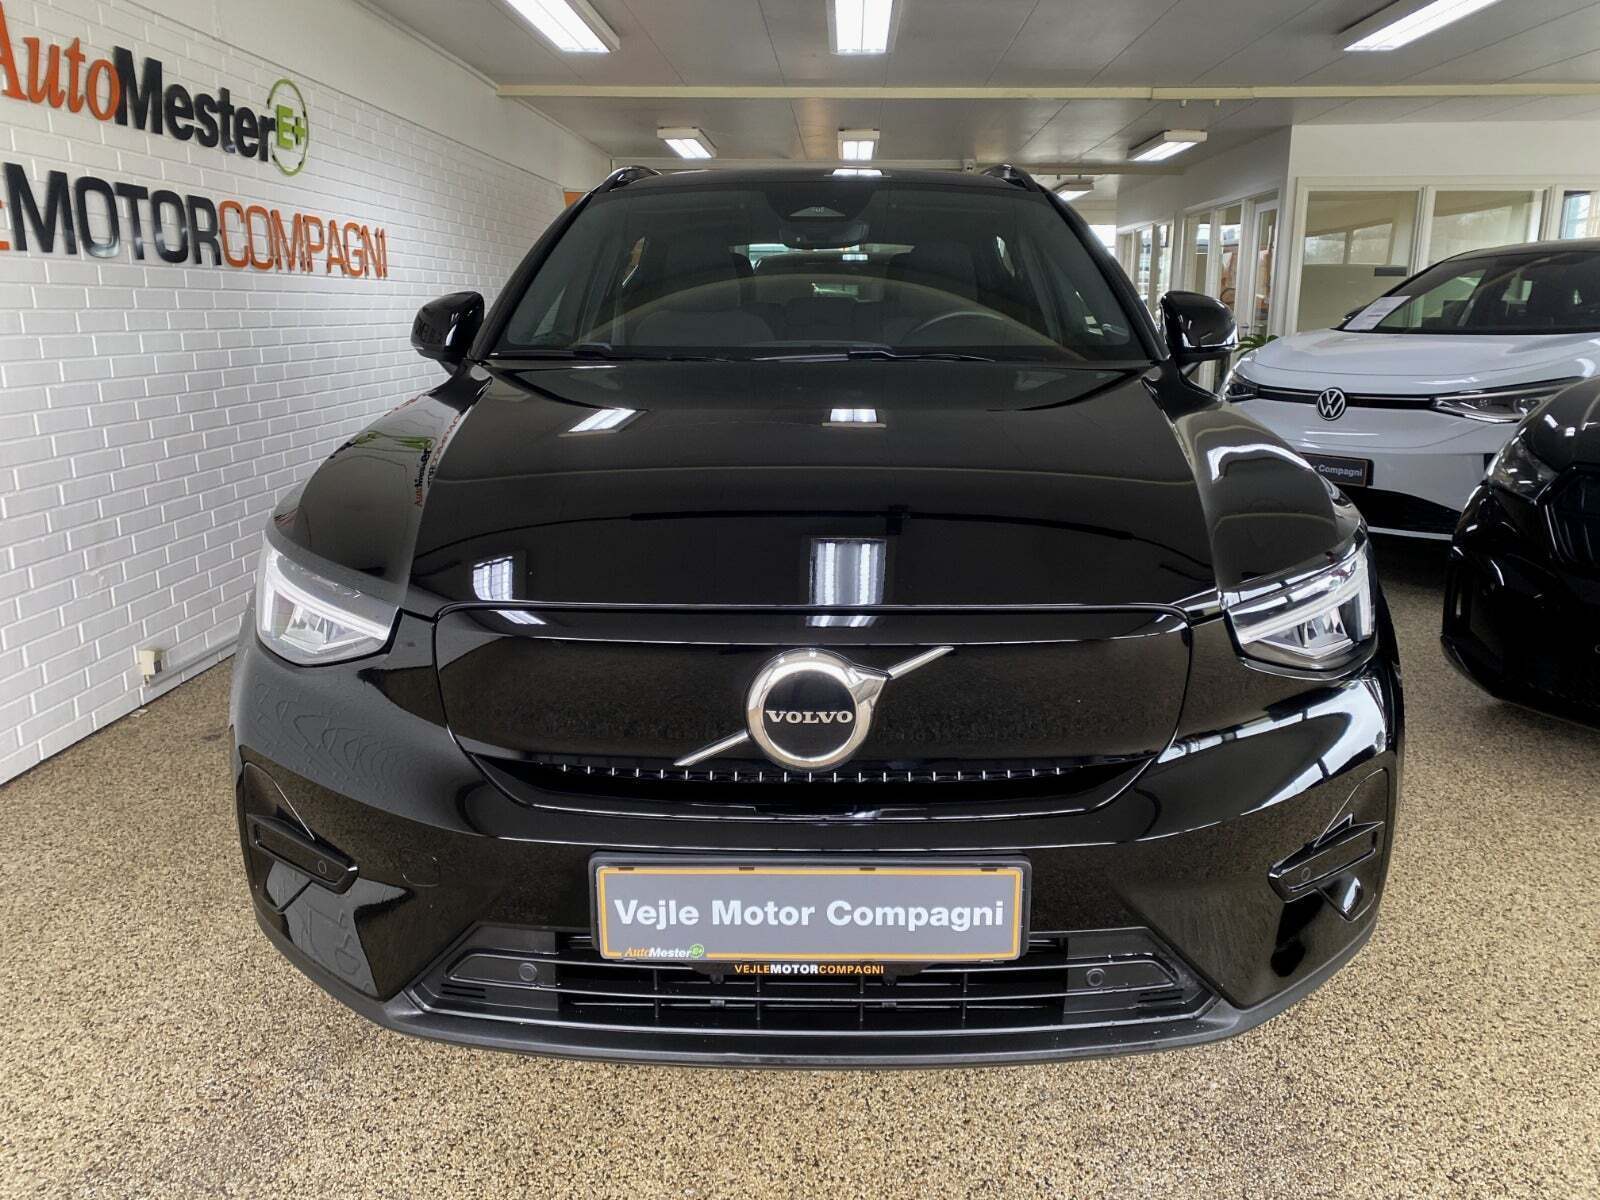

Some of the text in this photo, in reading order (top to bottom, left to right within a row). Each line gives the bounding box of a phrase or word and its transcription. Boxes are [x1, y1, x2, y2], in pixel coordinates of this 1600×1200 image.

[0, 162, 389, 280] MOTORCOMPAGNI
[1318, 464, 1363, 478] Compagni
[765, 709, 854, 724] VOLVO
[614, 899, 1004, 932] Vejle Motor Compagni
[624, 946, 690, 958] AutoMester
[734, 964, 884, 975] VEJLEMOTORCOMPAGNI
